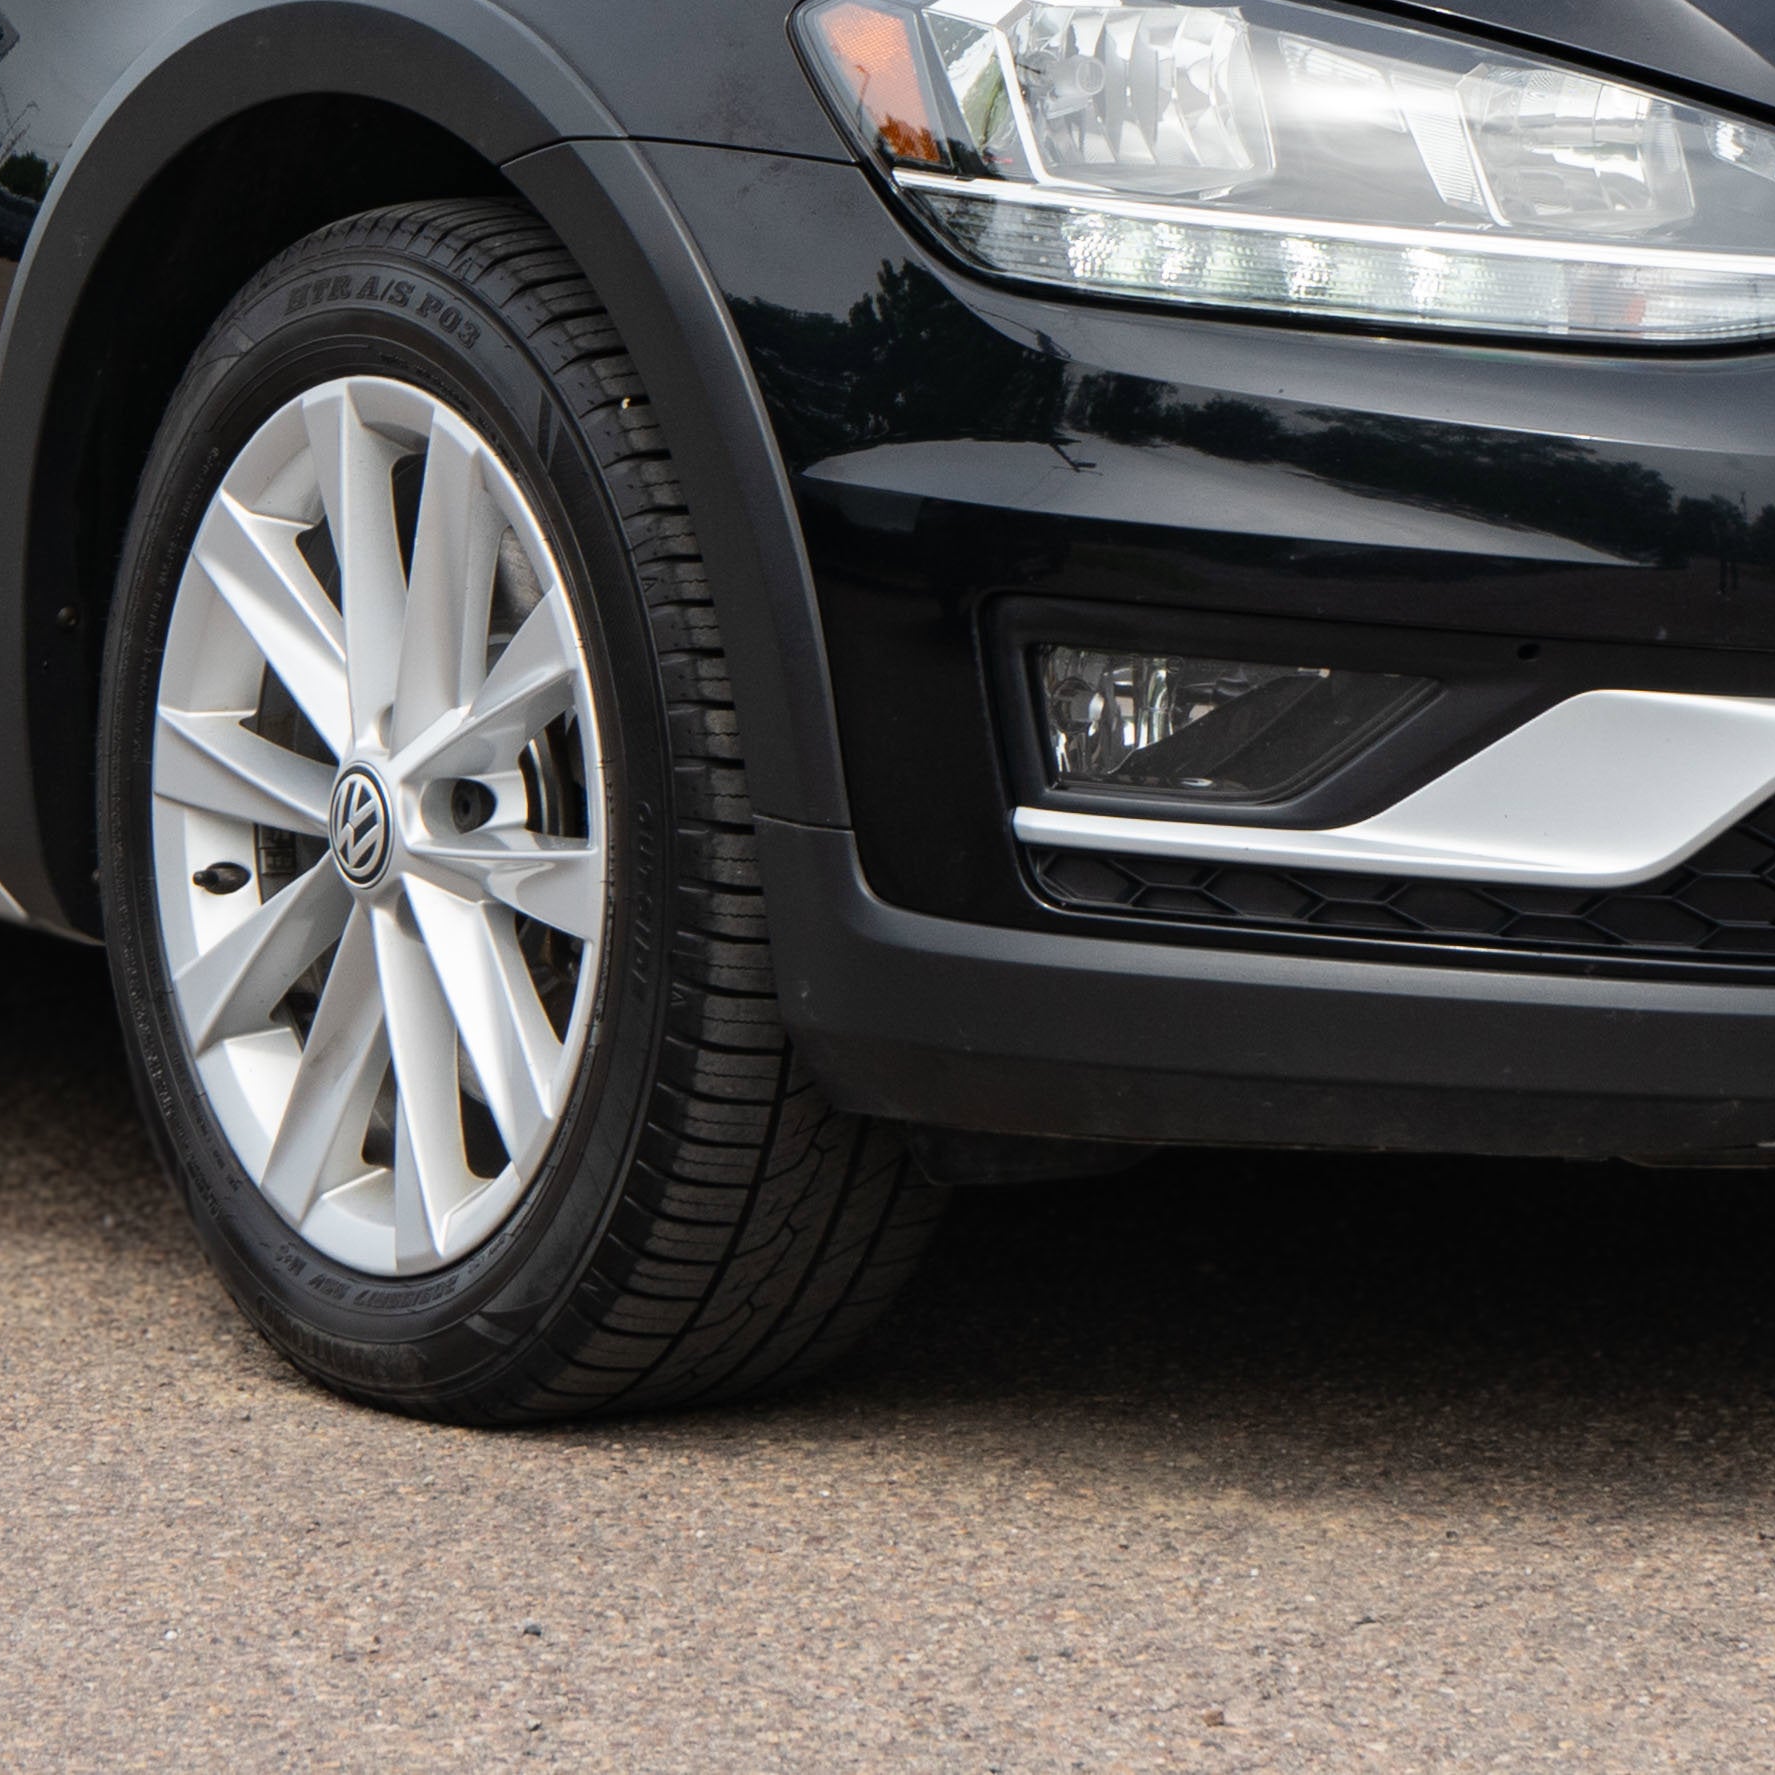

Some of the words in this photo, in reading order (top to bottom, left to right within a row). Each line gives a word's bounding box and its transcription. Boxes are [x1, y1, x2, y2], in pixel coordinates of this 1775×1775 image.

[284, 274, 353, 316] HTR
[355, 275, 416, 309] A/S
[415, 291, 482, 350] P03
